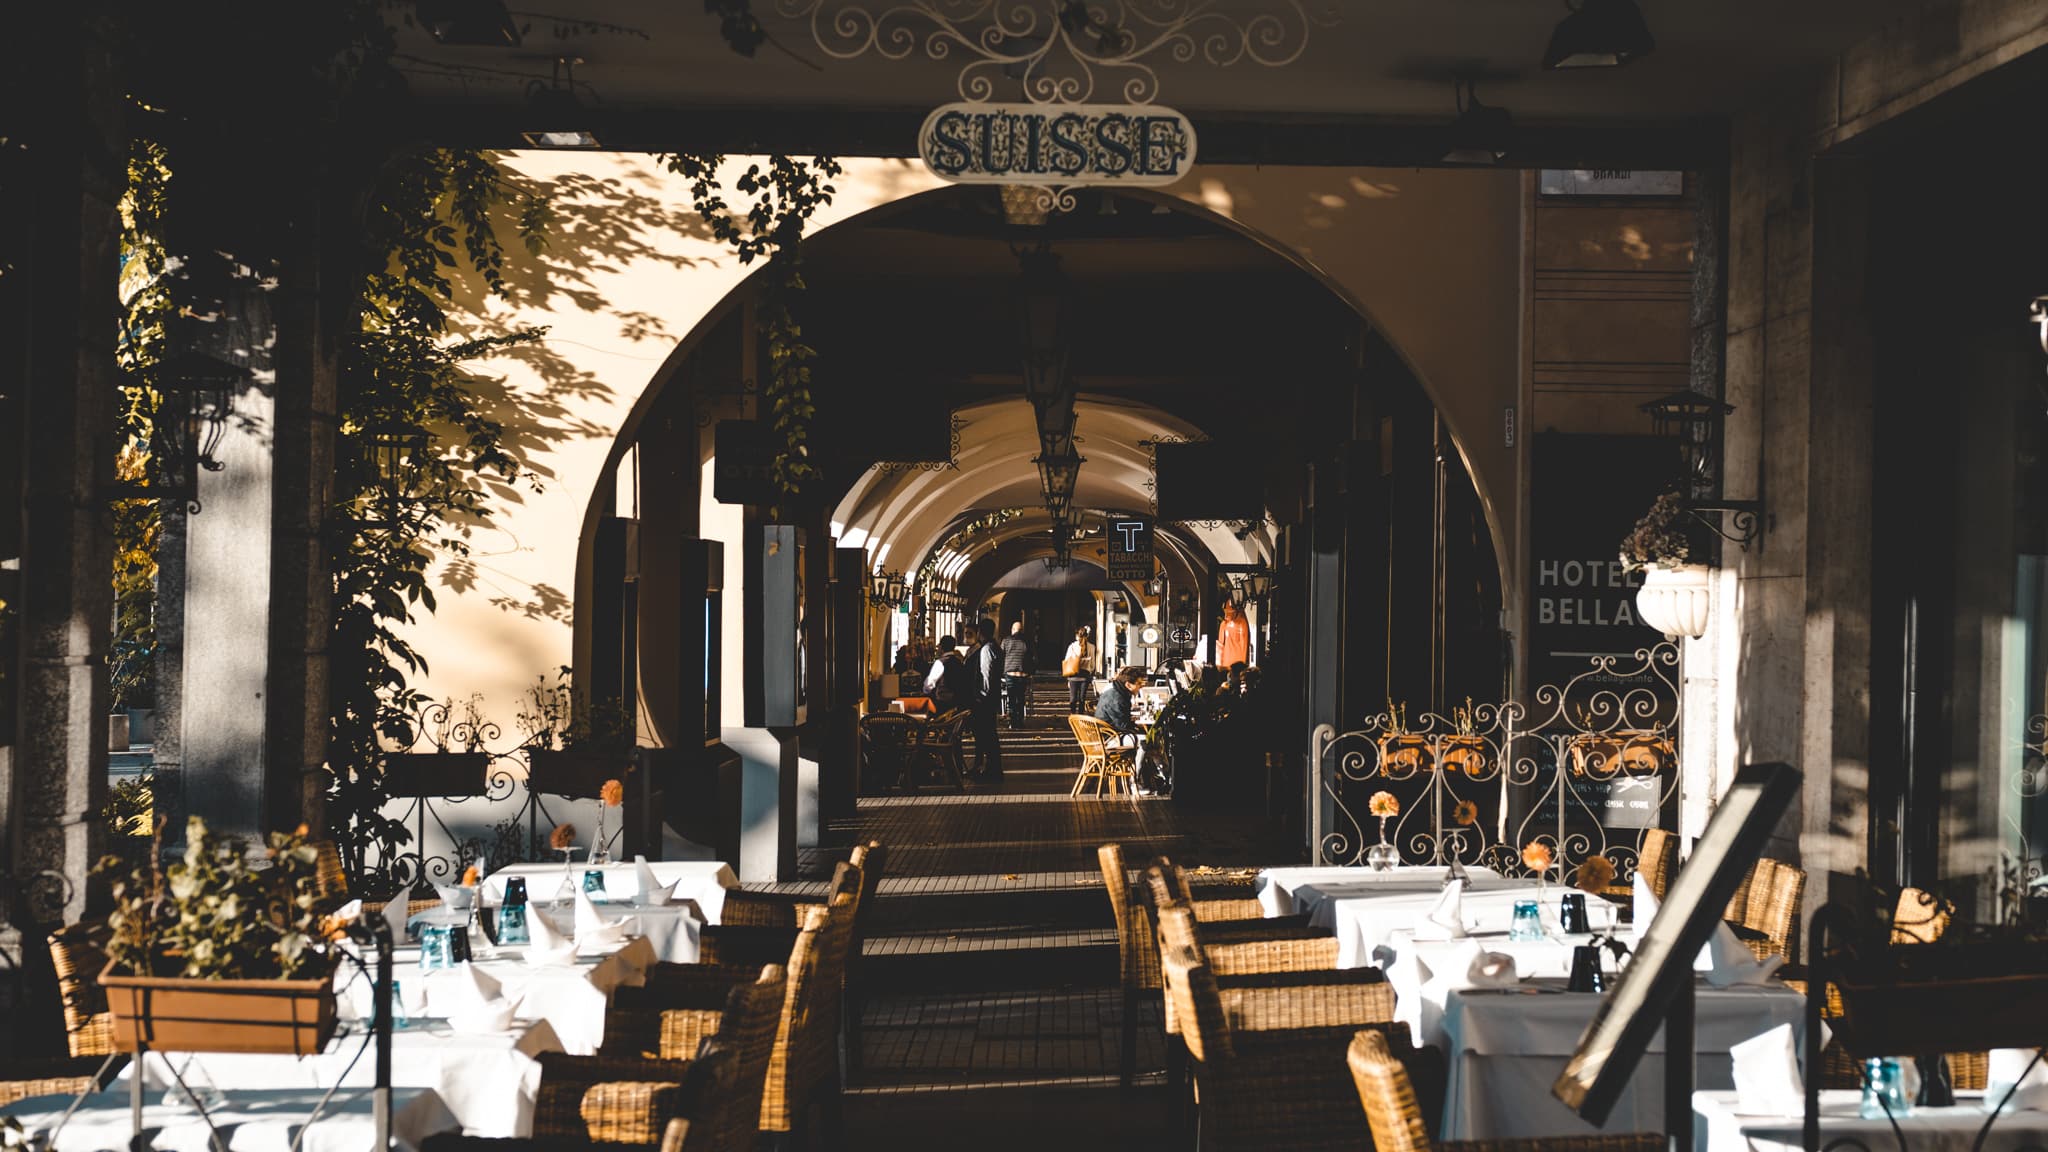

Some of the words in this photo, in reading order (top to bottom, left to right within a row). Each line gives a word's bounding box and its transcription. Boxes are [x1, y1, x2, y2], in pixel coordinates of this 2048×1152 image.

[934, 110, 1180, 176] SUISSE
[1116, 522, 1144, 552] T
[1109, 552, 1153, 563] TABACCHI
[1110, 569, 1146, 579] LOTTO
[1539, 559, 1640, 588] HOTEL
[1539, 597, 1647, 626] BELLA
